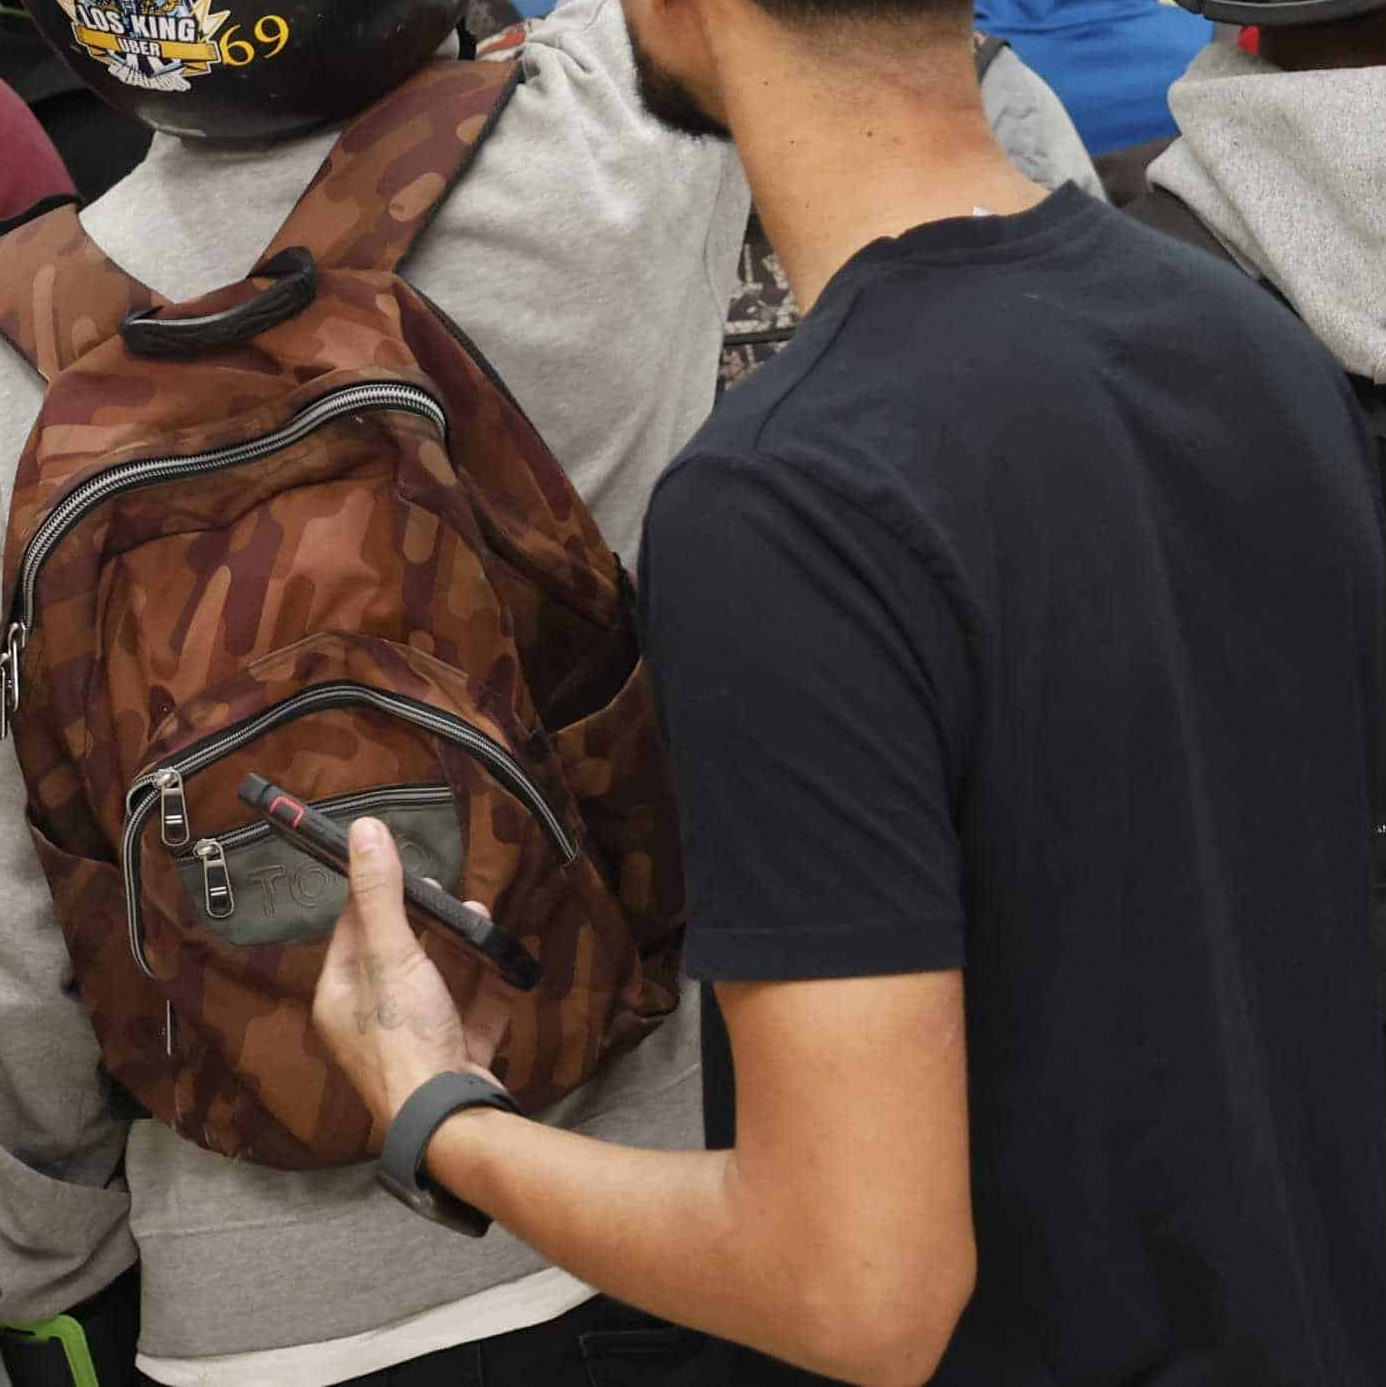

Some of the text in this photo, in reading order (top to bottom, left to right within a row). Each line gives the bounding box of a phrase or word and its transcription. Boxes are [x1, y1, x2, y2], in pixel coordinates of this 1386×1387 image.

[78, 5, 196, 42] LOS KING
[219, 15, 289, 66] 69
[118, 36, 161, 58] UBER
